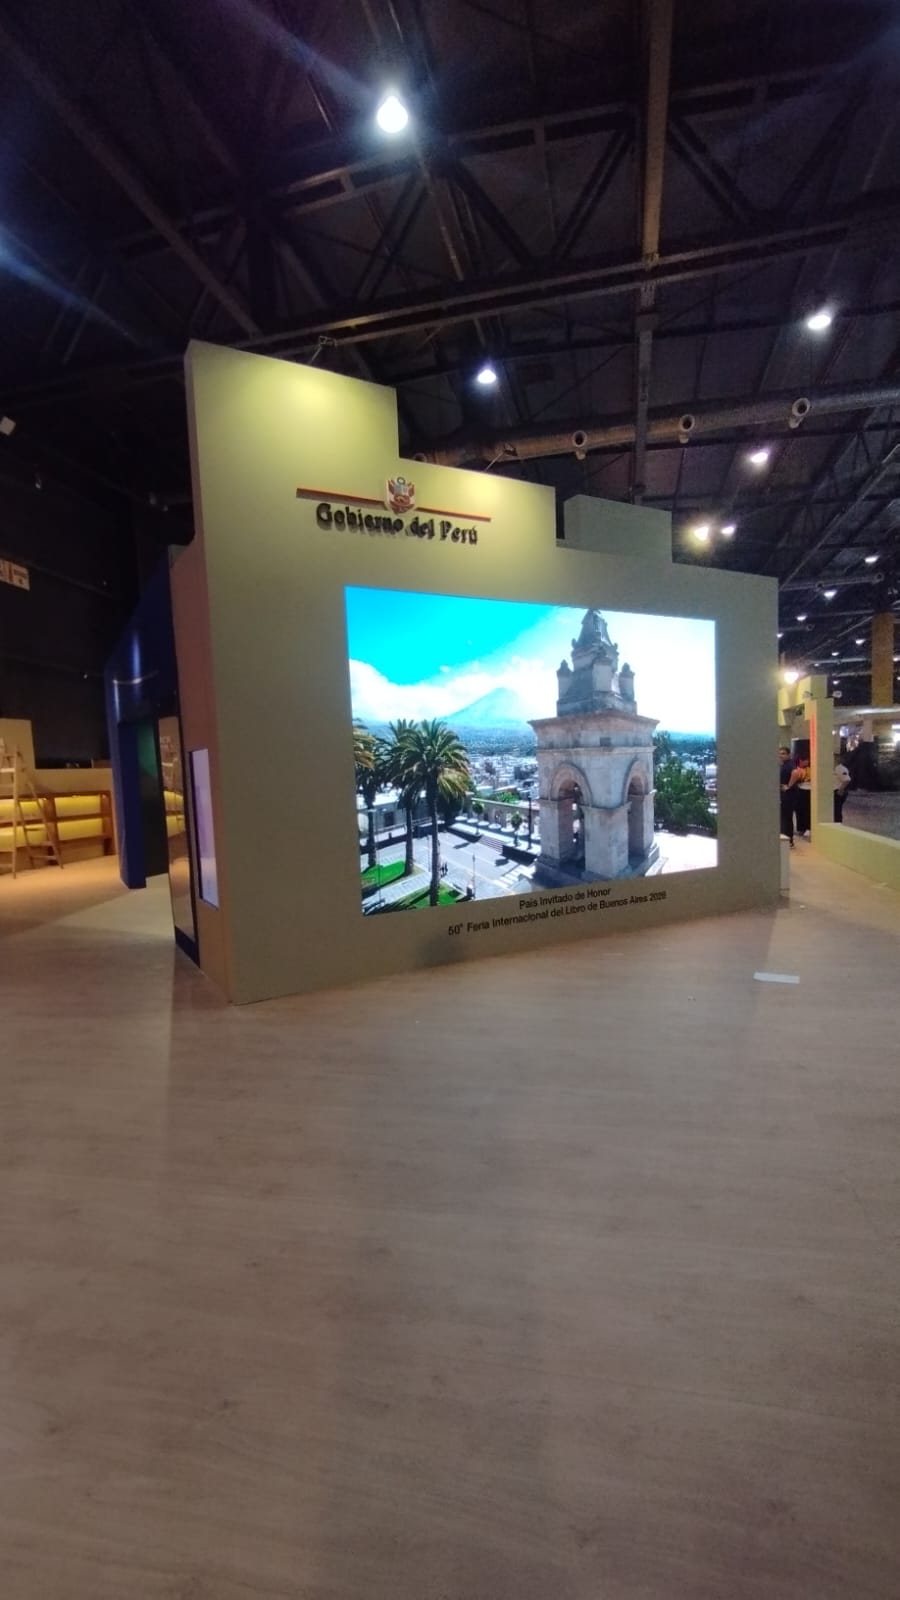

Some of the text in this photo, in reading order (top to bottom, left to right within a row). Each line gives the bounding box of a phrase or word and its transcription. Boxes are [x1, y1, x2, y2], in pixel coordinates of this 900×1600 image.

[316, 502, 478, 545] Gobierno del Perú
[467, 920, 490, 932] Feria
[493, 910, 549, 928] Internacional
[551, 906, 563, 917] del
[565, 904, 586, 915] Libro
[588, 902, 598, 911] de
[600, 898, 628, 910] Buenos
[630, 894, 648, 904] Aires
[519, 888, 611, 909] País Invitado de Honor
